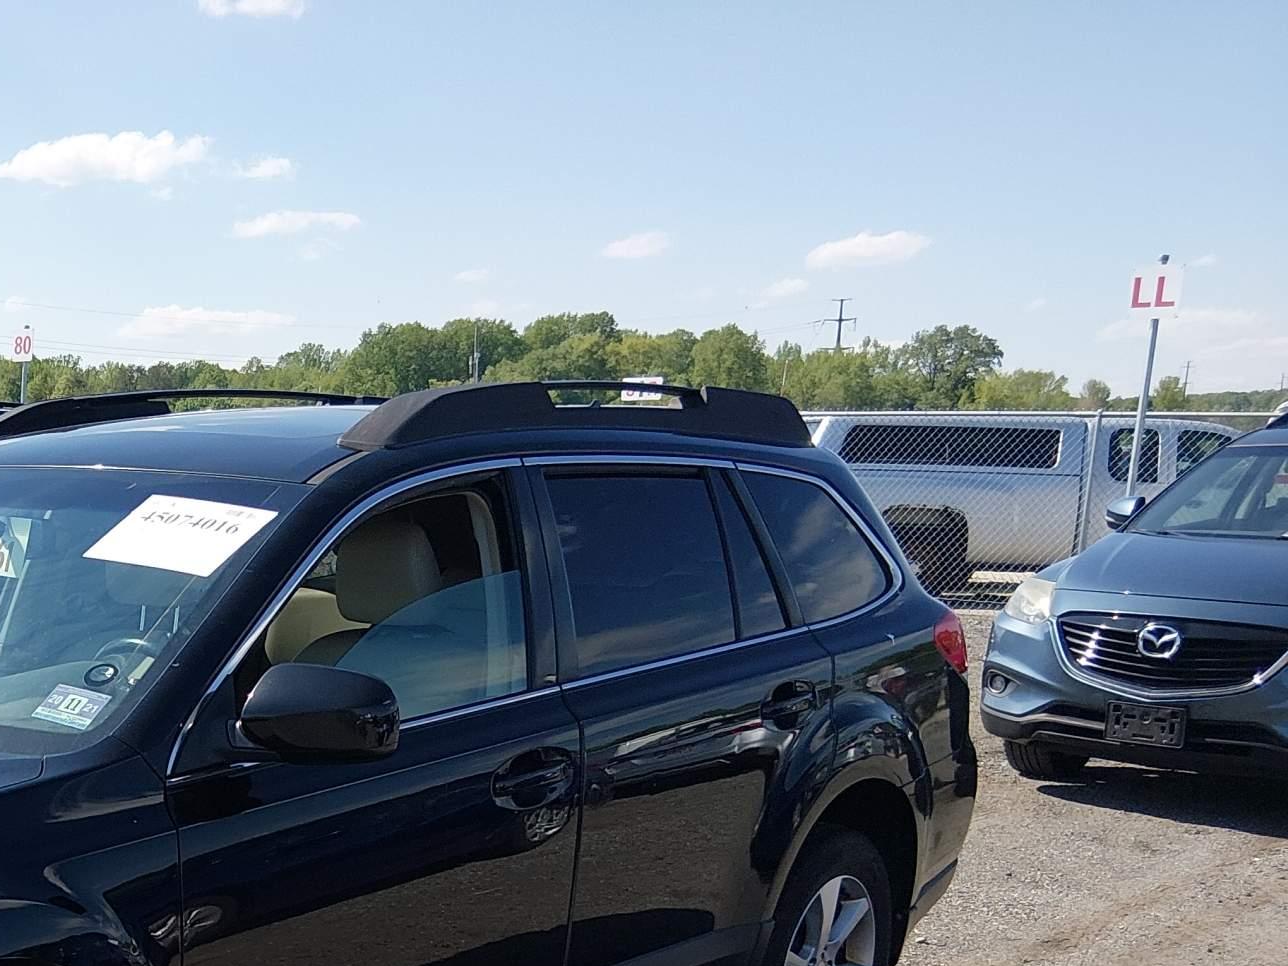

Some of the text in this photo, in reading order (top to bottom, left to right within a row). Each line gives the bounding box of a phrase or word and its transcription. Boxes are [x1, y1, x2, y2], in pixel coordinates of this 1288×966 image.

[1131, 276, 1175, 308] LL
[14, 335, 32, 355] 80
[140, 510, 240, 535] 45074016
[47, 694, 99, 714] 20 11 21
